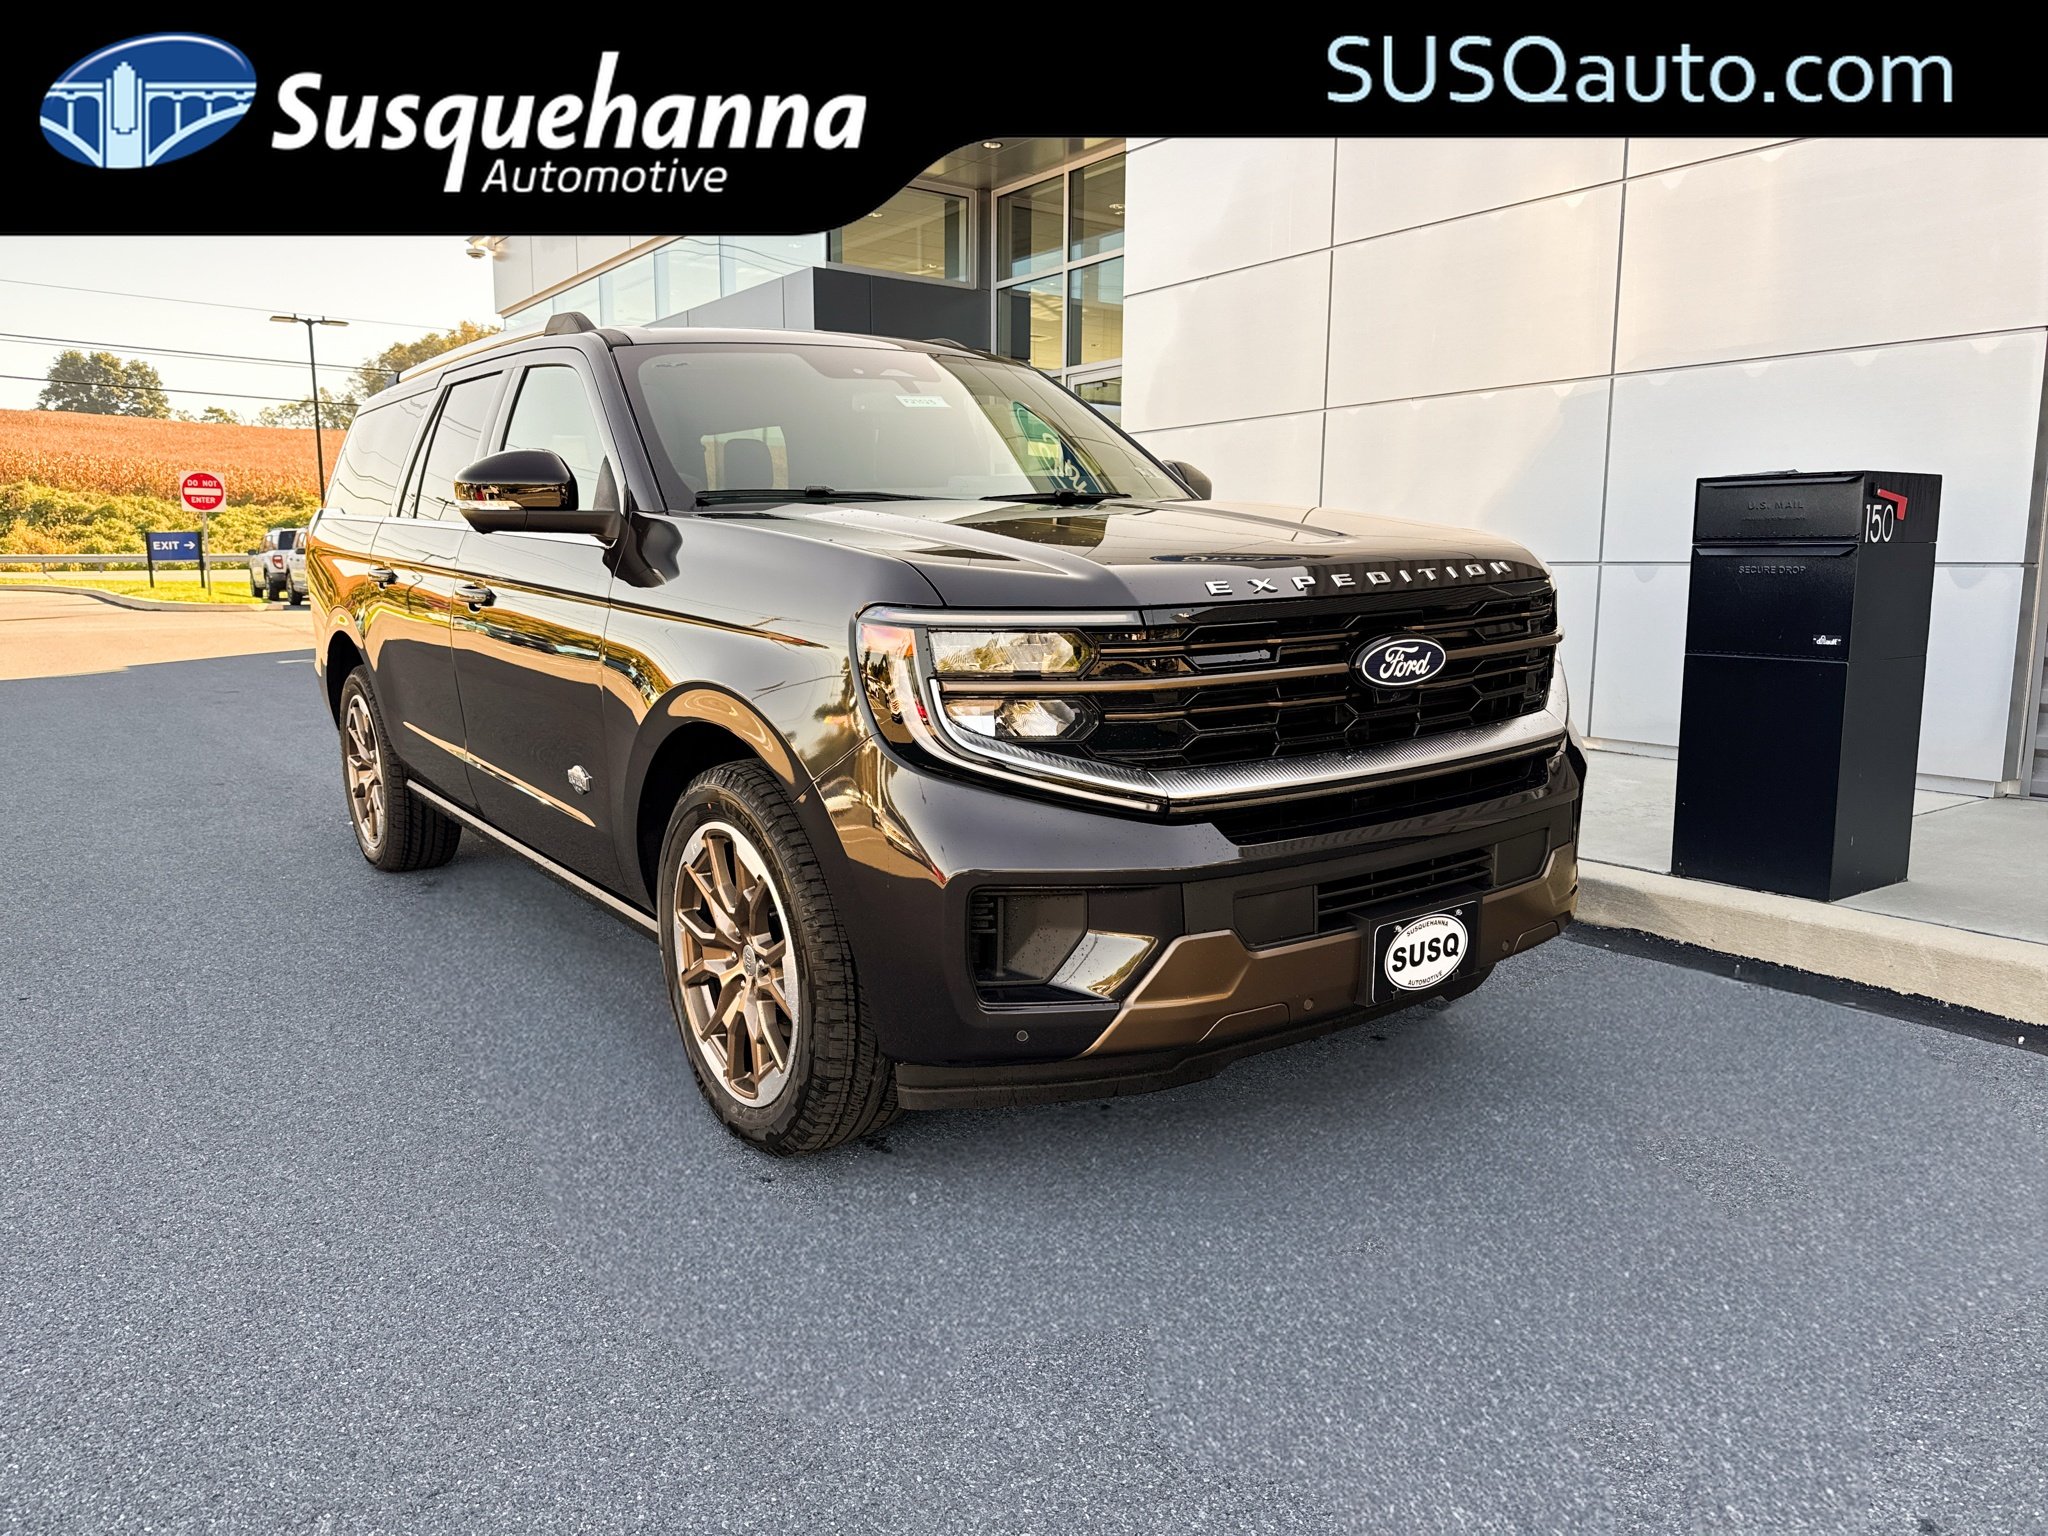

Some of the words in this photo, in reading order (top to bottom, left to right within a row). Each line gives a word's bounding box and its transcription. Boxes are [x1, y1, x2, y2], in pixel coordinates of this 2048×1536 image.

[187, 479, 198, 487] DO
[191, 496, 216, 504] ENTER
[1774, 499, 1804, 509] MAIL
[1865, 504, 1894, 543] 150
[153, 541, 180, 550] EXIT
[1738, 565, 1777, 574] SECURE
[1778, 565, 1807, 575] DROP
[1204, 561, 1512, 596] EXPEDITION
[1380, 646, 1431, 679] Ford
[1406, 919, 1449, 937] SUSQUEHANNA
[1391, 932, 1460, 973] SUSQ
[1407, 970, 1443, 986] AUTOMOTIVE
